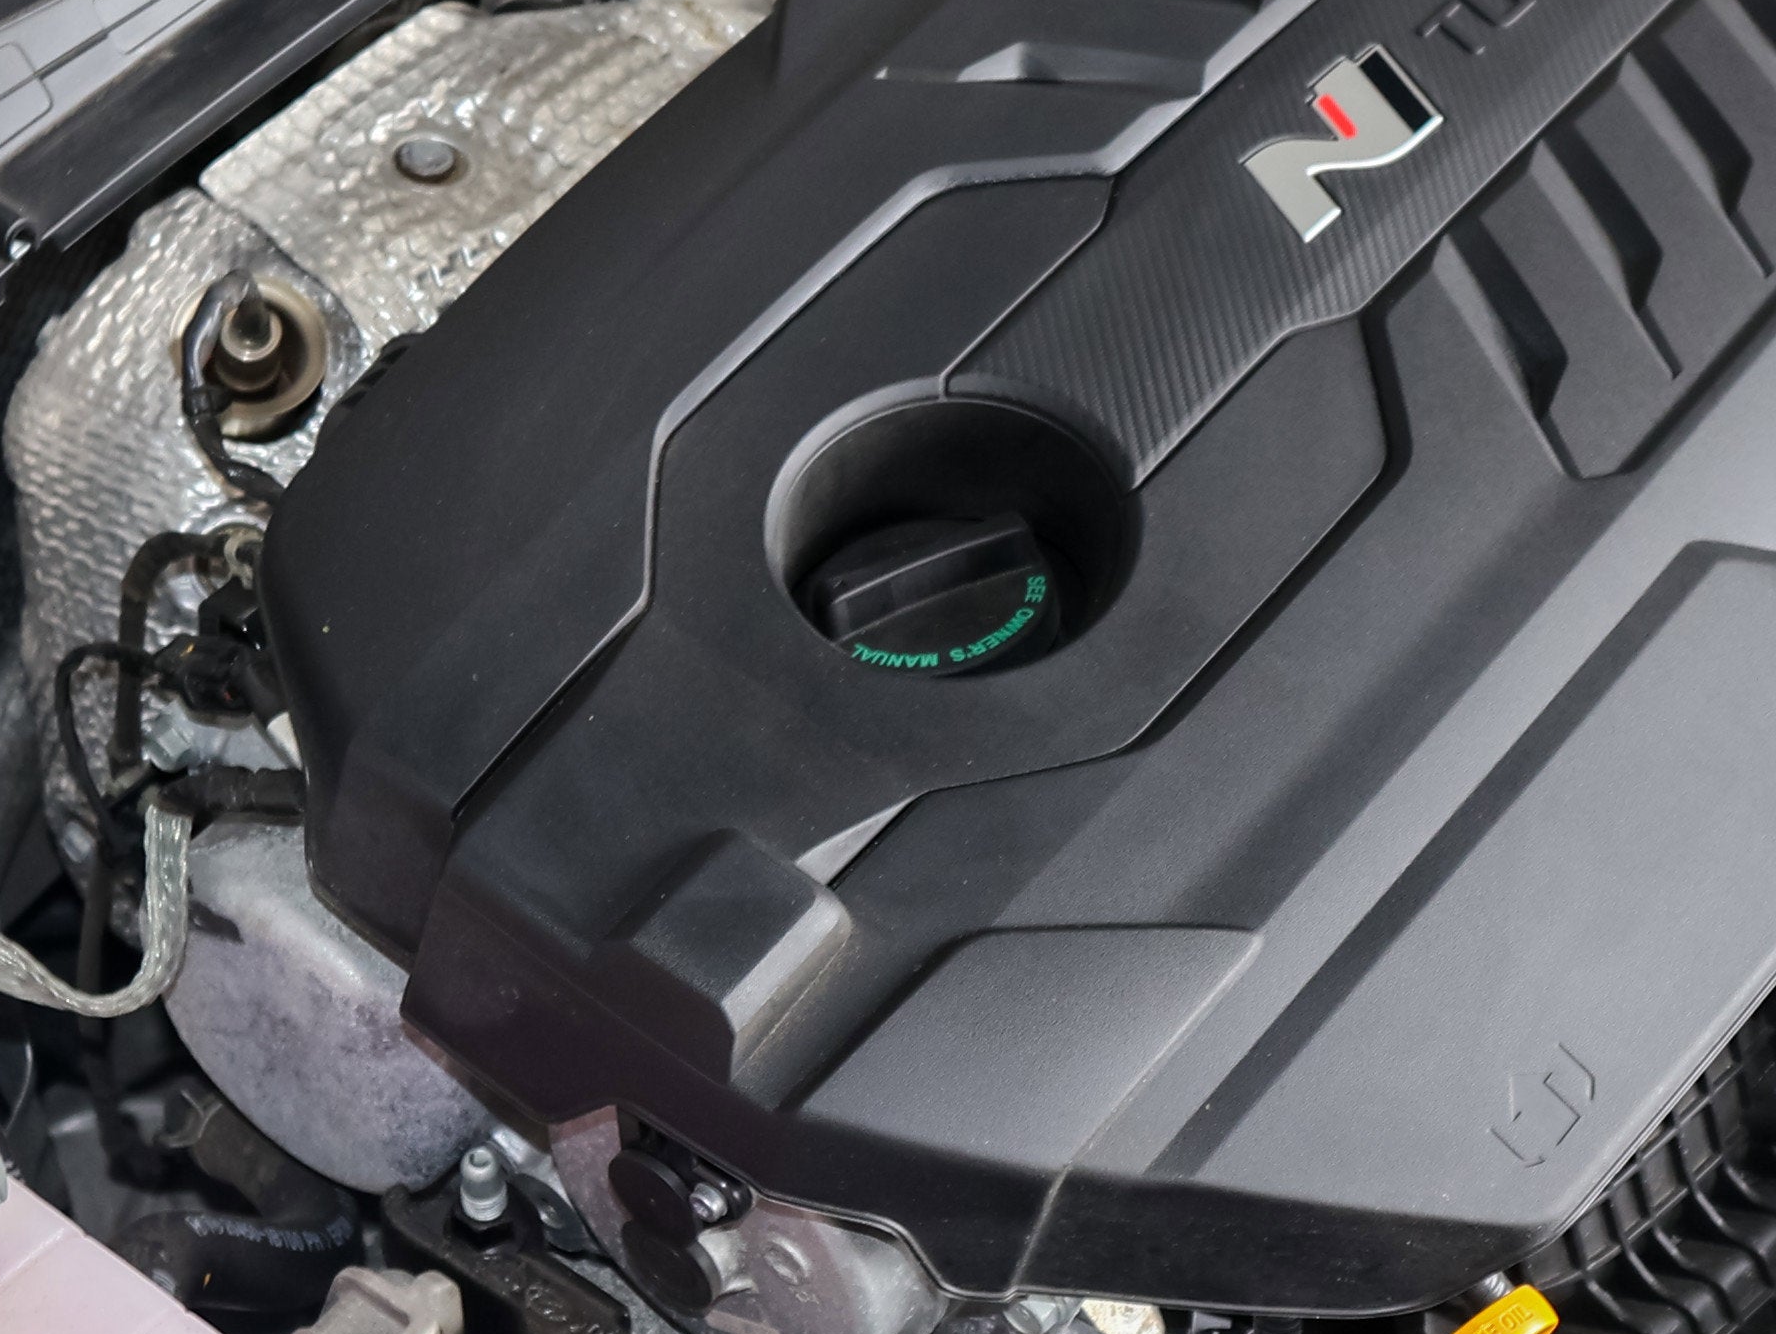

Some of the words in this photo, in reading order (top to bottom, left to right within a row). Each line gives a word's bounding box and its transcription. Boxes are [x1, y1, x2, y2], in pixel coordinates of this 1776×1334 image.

[1025, 574, 1047, 603] SEE
[952, 608, 1036, 663] OWNER'S
[851, 642, 939, 668] MANUAL
[1498, 1302, 1534, 1334] OIL
